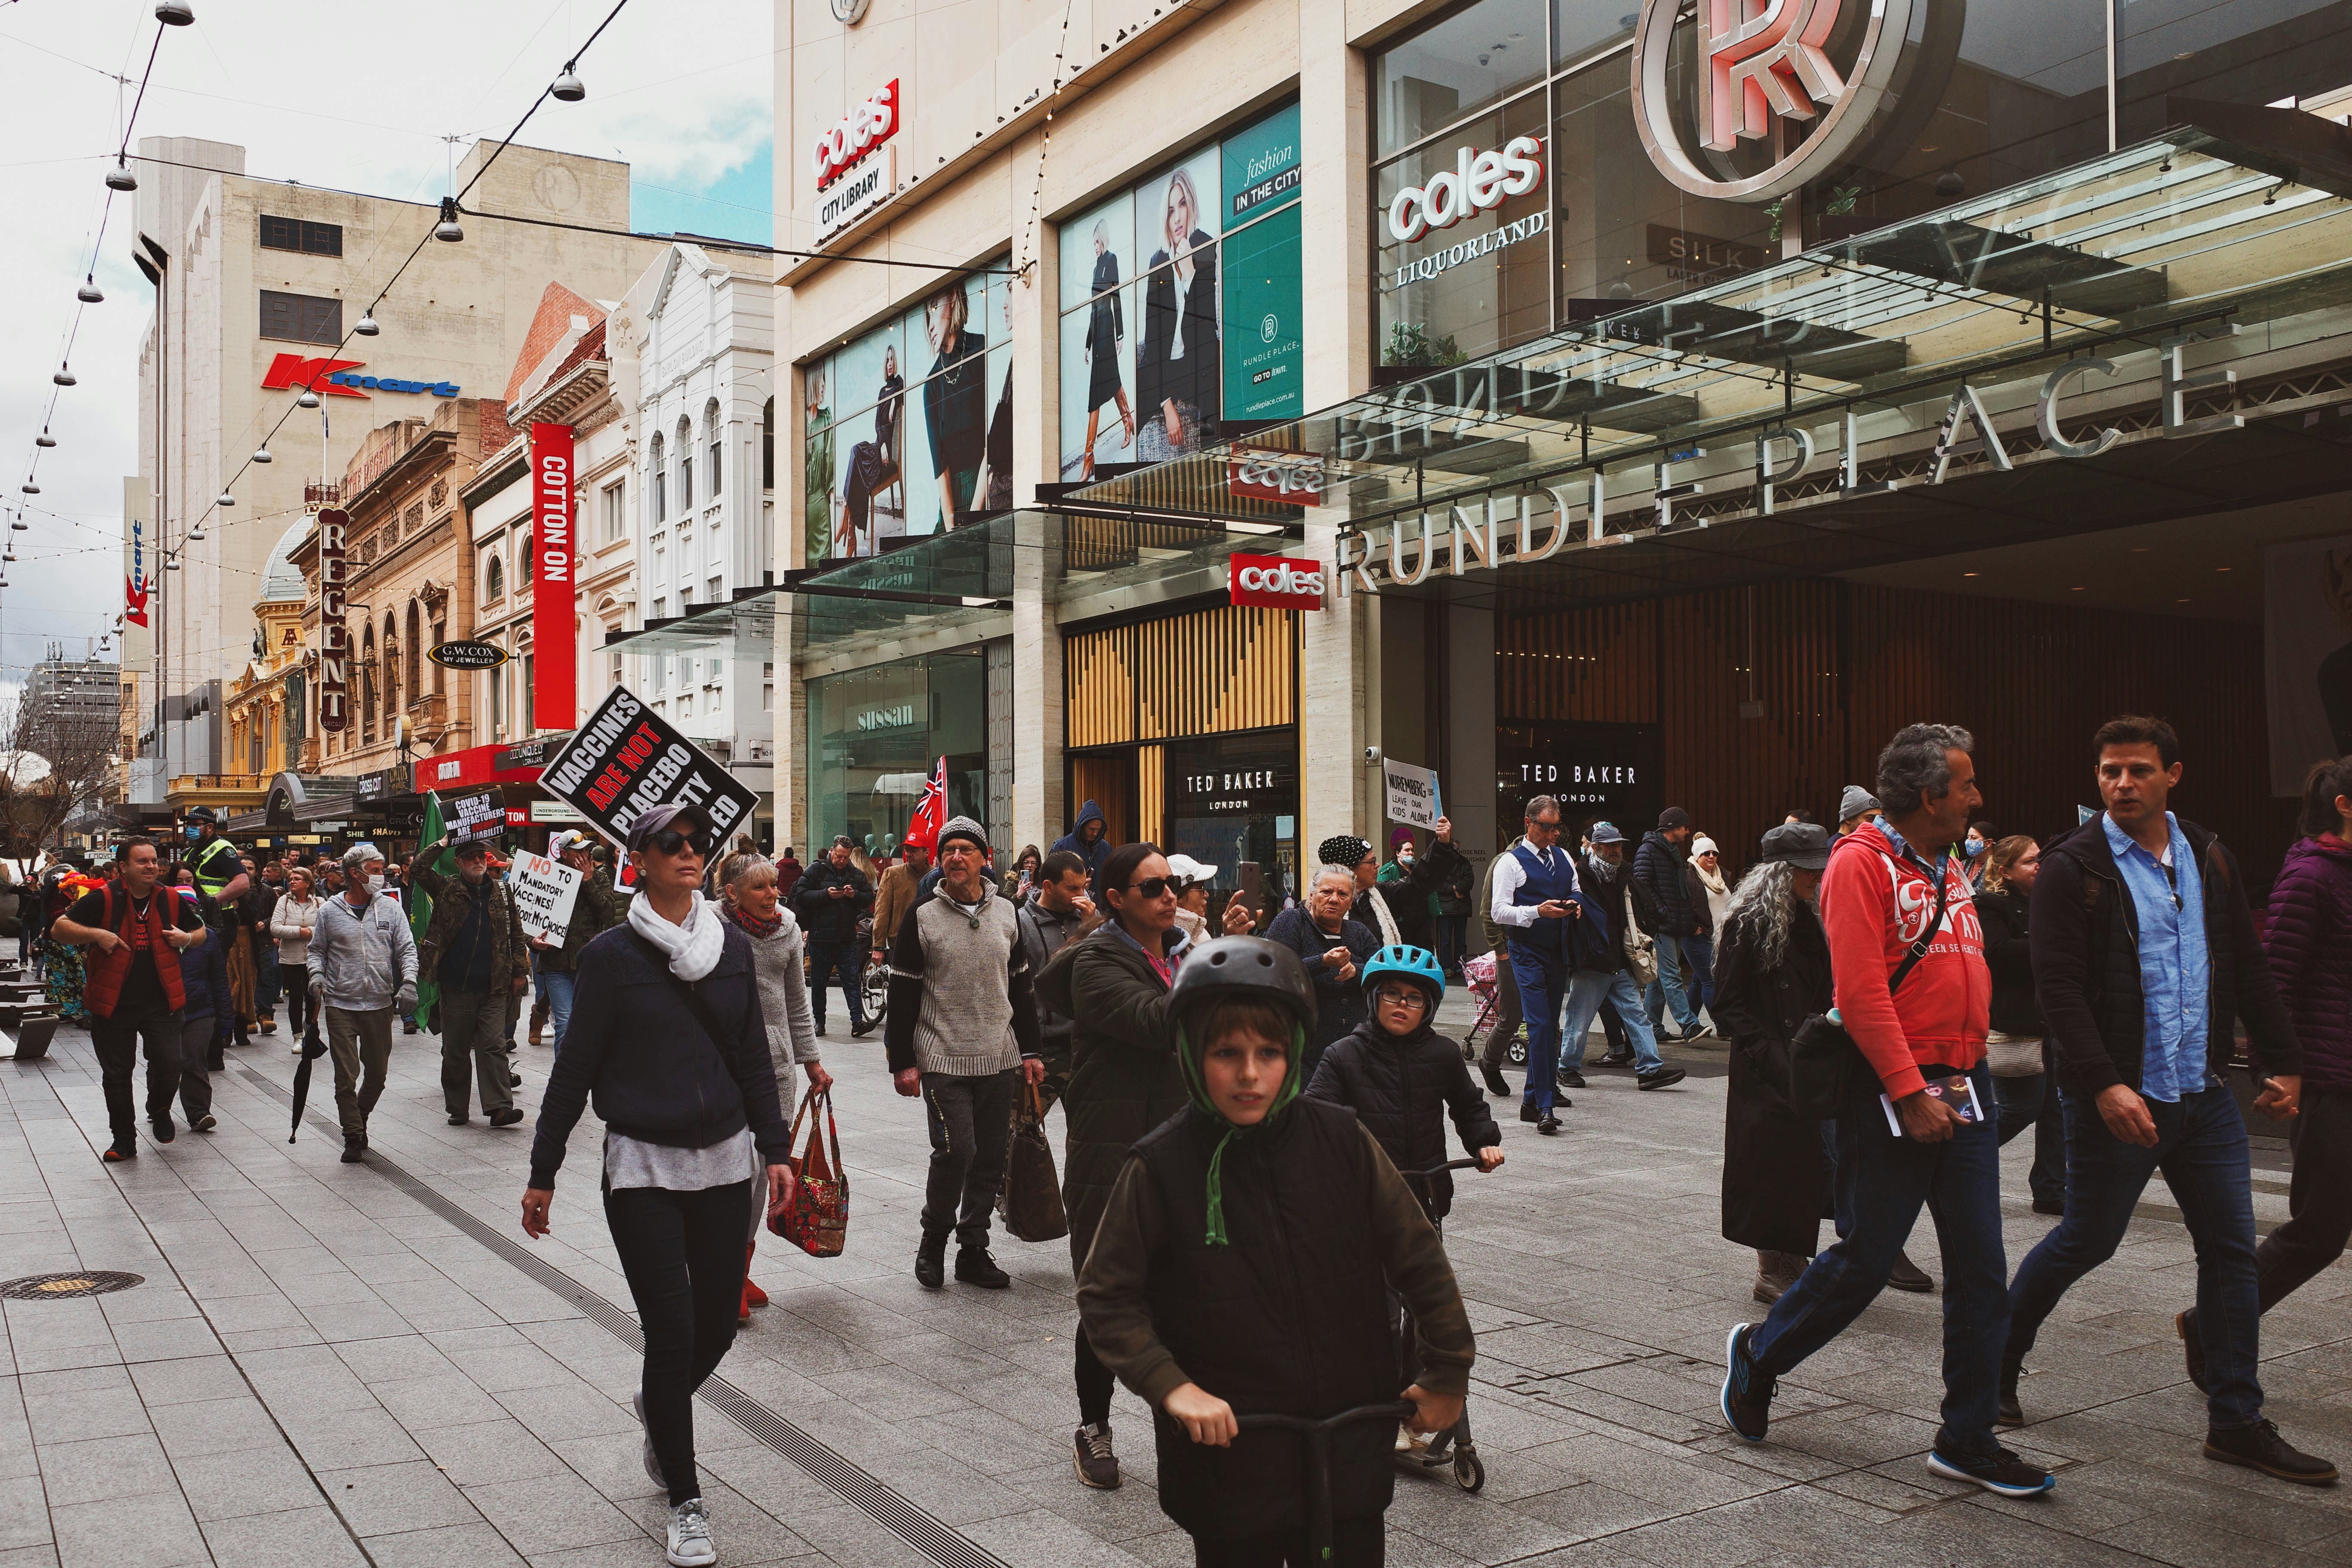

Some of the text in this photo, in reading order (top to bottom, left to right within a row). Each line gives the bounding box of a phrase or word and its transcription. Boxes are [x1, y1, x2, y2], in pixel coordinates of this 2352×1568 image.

[811, 87, 892, 178] coles
[1244, 145, 1292, 187] fashion
[822, 168, 879, 225] CITY LIBRARY
[1237, 166, 1301, 211] IN THE CITY
[1389, 136, 1545, 243] coles
[1396, 212, 1545, 287] LIQUORLAND
[1670, 237, 1743, 269] SILK
[1667, 268, 1698, 283] LASER
[1243, 350, 1271, 367] RUNDLE
[1253, 374, 1262, 383] GO
[1262, 371, 1270, 380] TO
[1246, 391, 1295, 414] rundleplace.com.au
[348, 438, 393, 501] THE REGENT
[1335, 323, 2245, 598] RUNDLE PLACE
[1239, 563, 1325, 596] coles
[322, 522, 345, 717] REGENT
[858, 704, 913, 731] sussan
[549, 693, 640, 795] VACCINES
[586, 722, 661, 812] ARE NOT
[1522, 764, 1635, 784] TED BAKER
[359, 779, 372, 794] CROSS
[373, 776, 382, 791] CUT
[610, 743, 691, 837] PLACEBO
[1187, 771, 1273, 792] TED BAKER
[1388, 773, 1426, 798] NUREMBERG
[455, 794, 490, 810] COVID-19
[458, 803, 491, 818] VACCINE
[1210, 800, 1249, 810] LONDON
[1392, 795, 1422, 809] LEAVE OUR
[1554, 794, 1605, 802] LONDON
[445, 807, 505, 831] MANUFACTURERS
[507, 812, 525, 822] TON
[1392, 806, 1406, 817] KIDS
[451, 825, 504, 846] FROM LIABILITY
[457, 825, 471, 837] ARE
[527, 856, 572, 884] NO TO
[519, 870, 564, 898] MANDATORY
